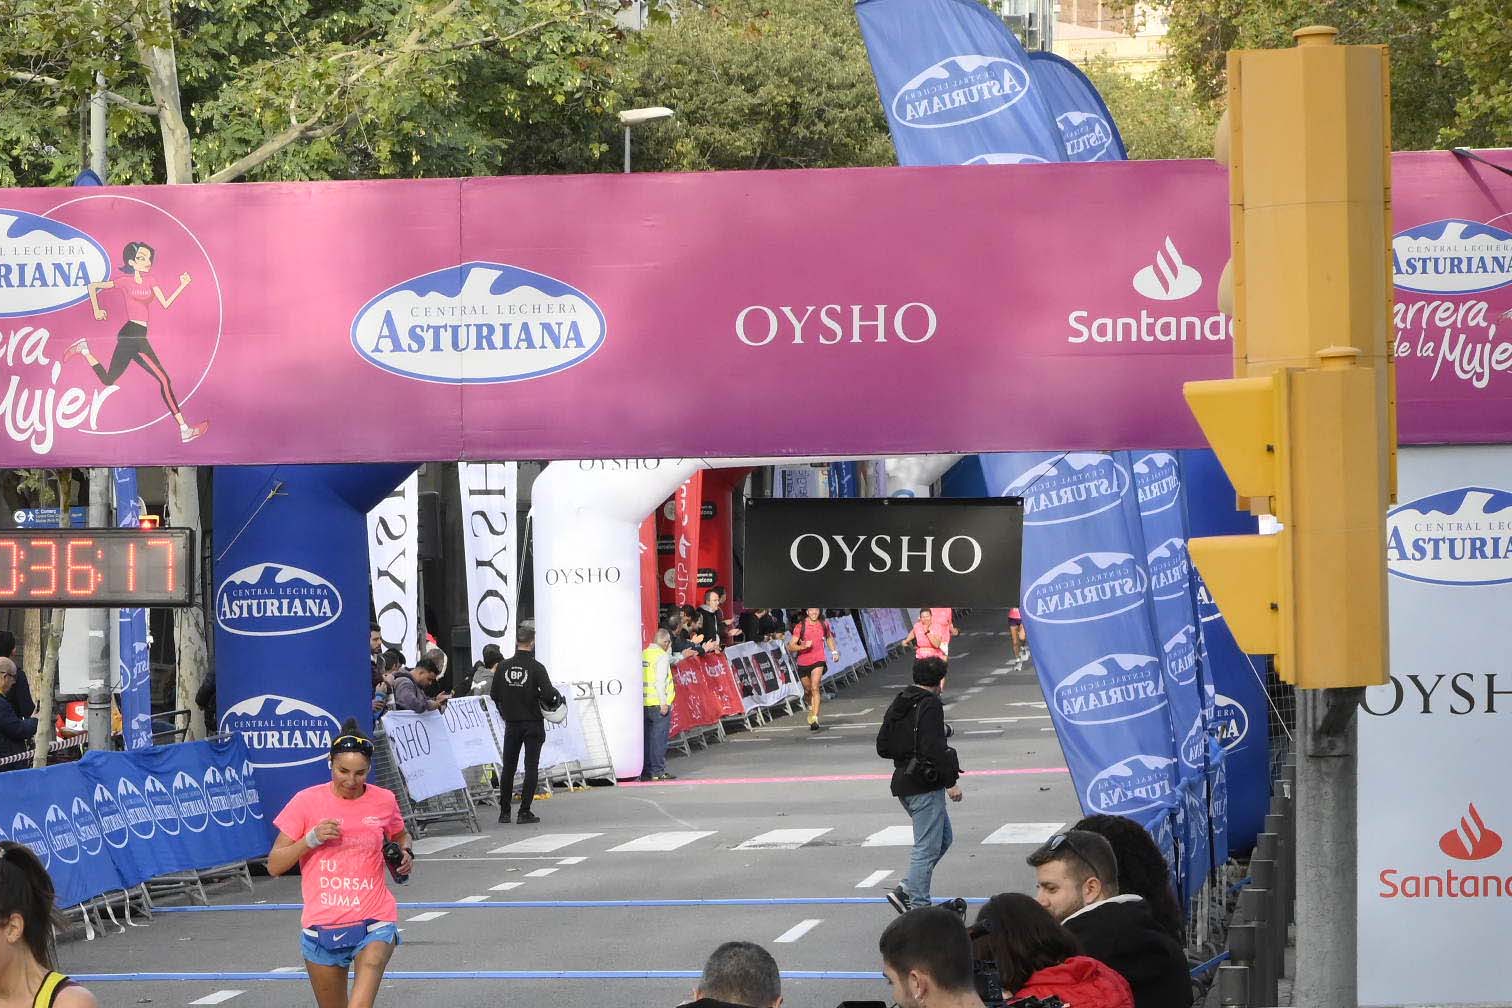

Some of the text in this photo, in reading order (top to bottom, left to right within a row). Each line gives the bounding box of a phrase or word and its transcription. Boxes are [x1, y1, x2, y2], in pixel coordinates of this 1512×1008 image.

[12, 245, 85, 257] LECHERA
[1407, 245, 1458, 254] CENTRAL
[410, 303, 577, 317] CENTRAL LECHERA
[1393, 299, 1489, 330] arrera
[370, 309, 586, 354] ASTURIANA
[735, 302, 938, 347] OYSHO
[1067, 310, 1234, 344] Santand
[1416, 323, 1512, 389] la Muje
[1414, 521, 1481, 533] CENTRAL
[789, 533, 982, 574] OYSHO
[545, 566, 621, 586] OYSHO
[232, 586, 329, 597] CENTRAL LECHERA
[220, 592, 333, 620] ASTURIANA
[1359, 672, 1512, 717] OYSH
[234, 718, 329, 728] CENTRAL LECHERA
[319, 860, 337, 872] TU
[320, 893, 361, 907] SUMA
